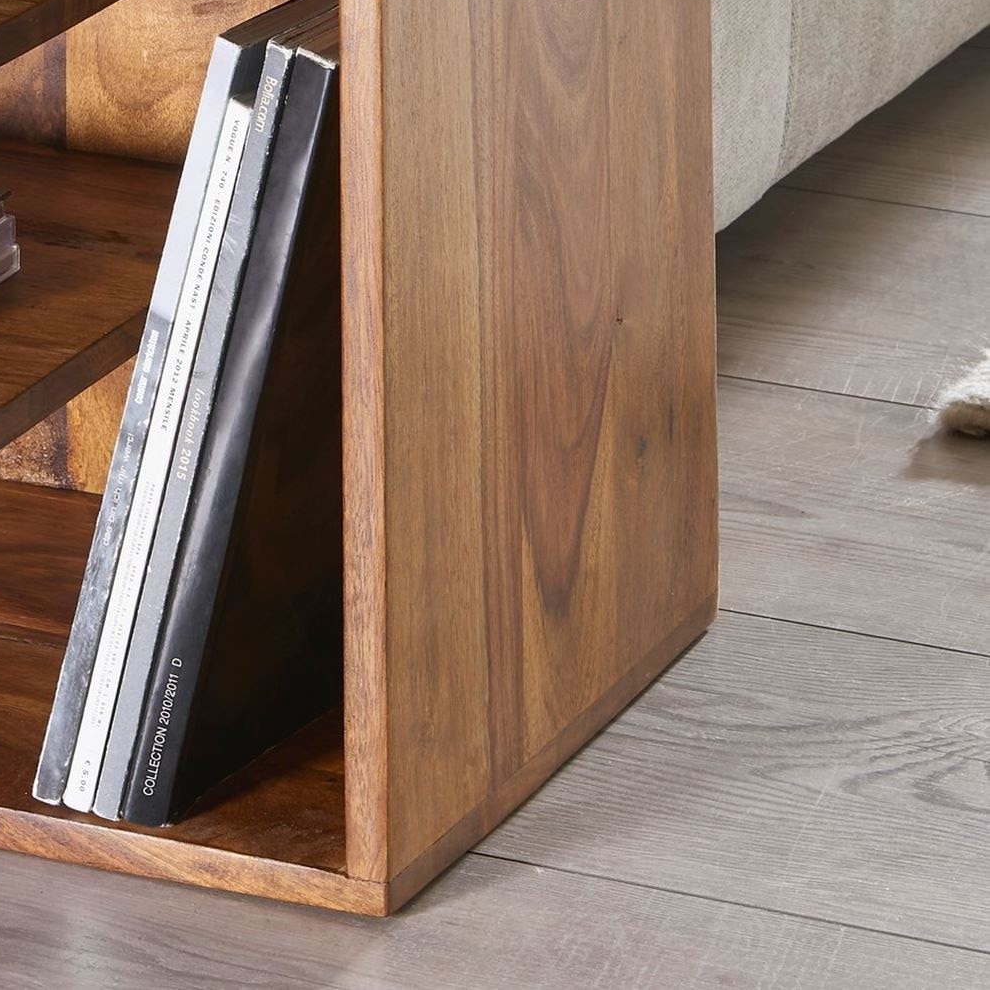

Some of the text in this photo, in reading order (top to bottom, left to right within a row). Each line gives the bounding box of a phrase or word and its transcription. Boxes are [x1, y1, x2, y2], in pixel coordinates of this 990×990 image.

[255, 75, 278, 133] Bolia.com
[227, 119, 240, 152] VOGUE
[218, 170, 228, 189] 740
[205, 199, 221, 244] EDIZIONI
[196, 247, 210, 281] CONDE
[189, 283, 201, 310] NAST
[181, 319, 192, 355] APRILE
[171, 358, 184, 384] 2012
[160, 387, 175, 430] MENSILE
[176, 387, 206, 481] lookbook 2015
[142, 657, 183, 797] COLLECTION 2010/2011 D
